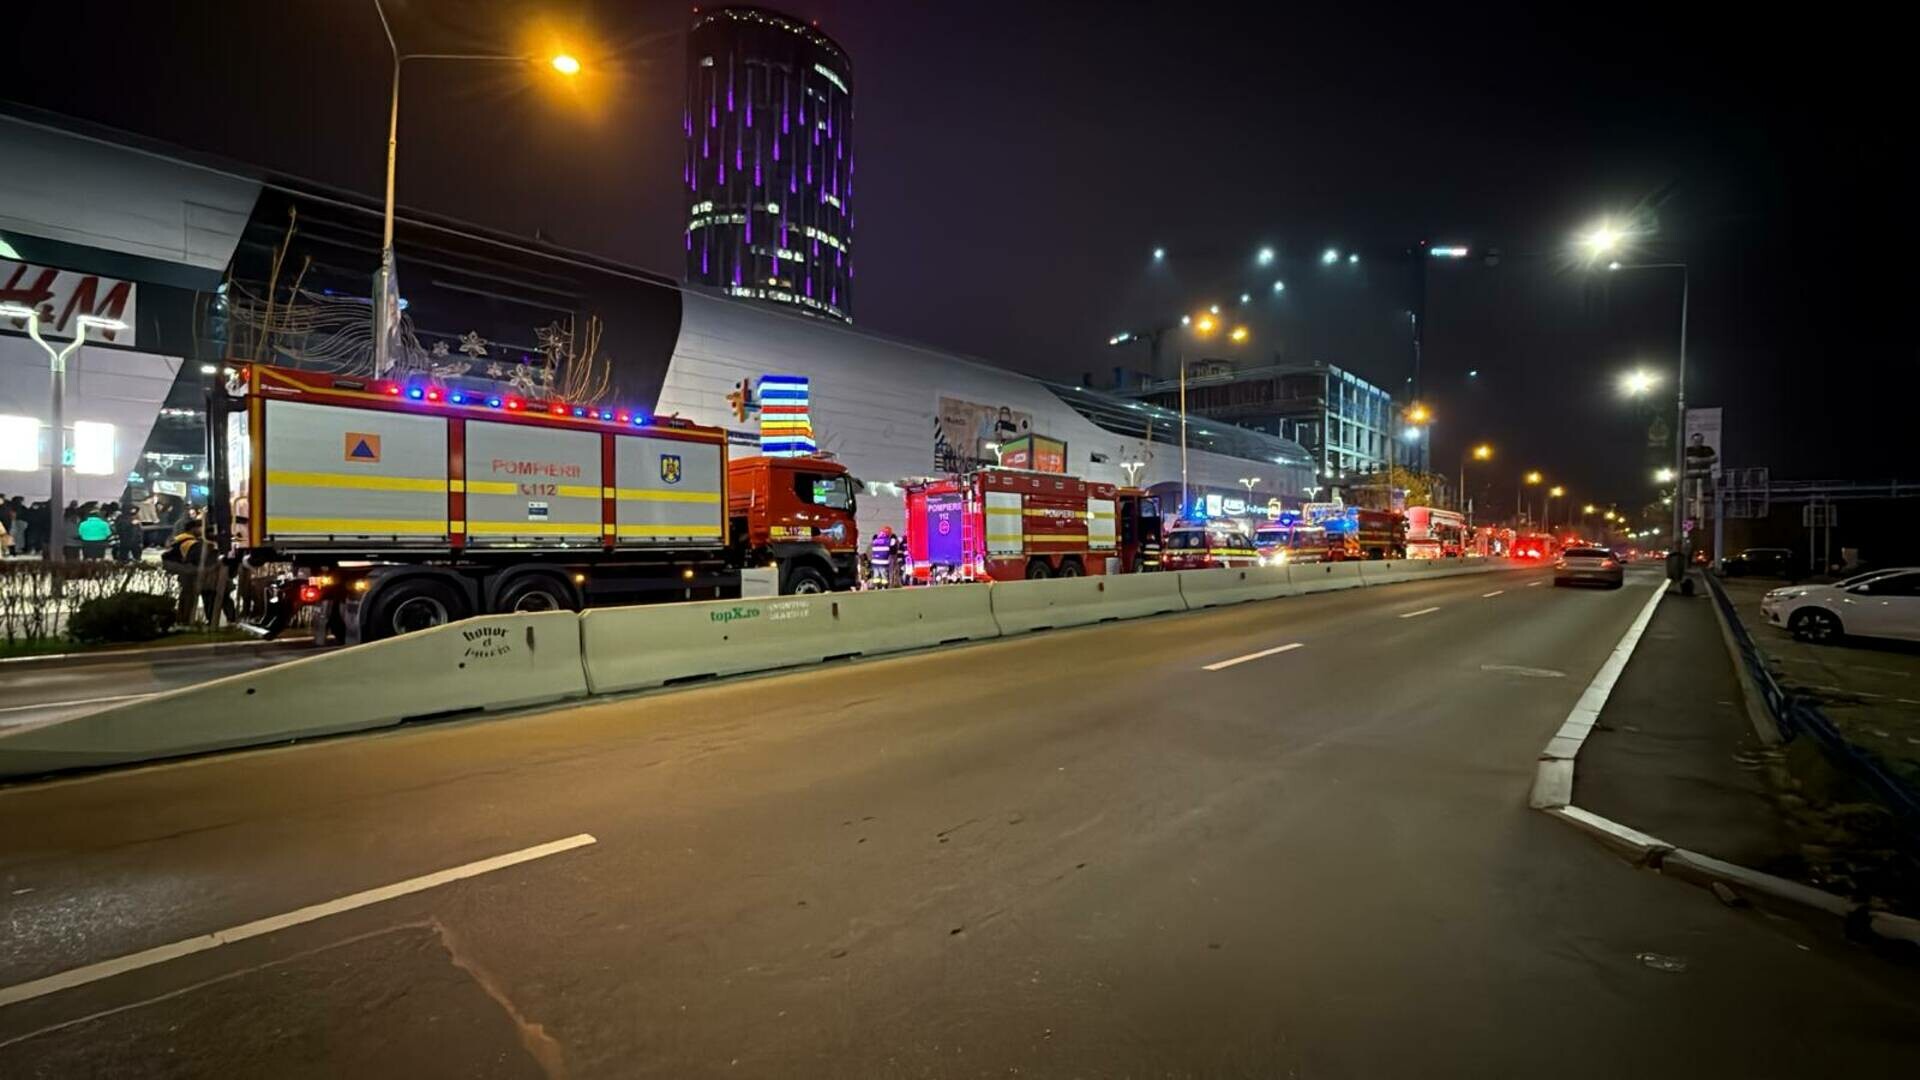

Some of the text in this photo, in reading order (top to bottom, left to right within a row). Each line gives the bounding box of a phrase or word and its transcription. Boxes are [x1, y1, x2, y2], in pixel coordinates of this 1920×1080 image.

[0, 263, 131, 341] H&M
[532, 484, 556, 496] 112
[711, 606, 760, 623] topX.ro
